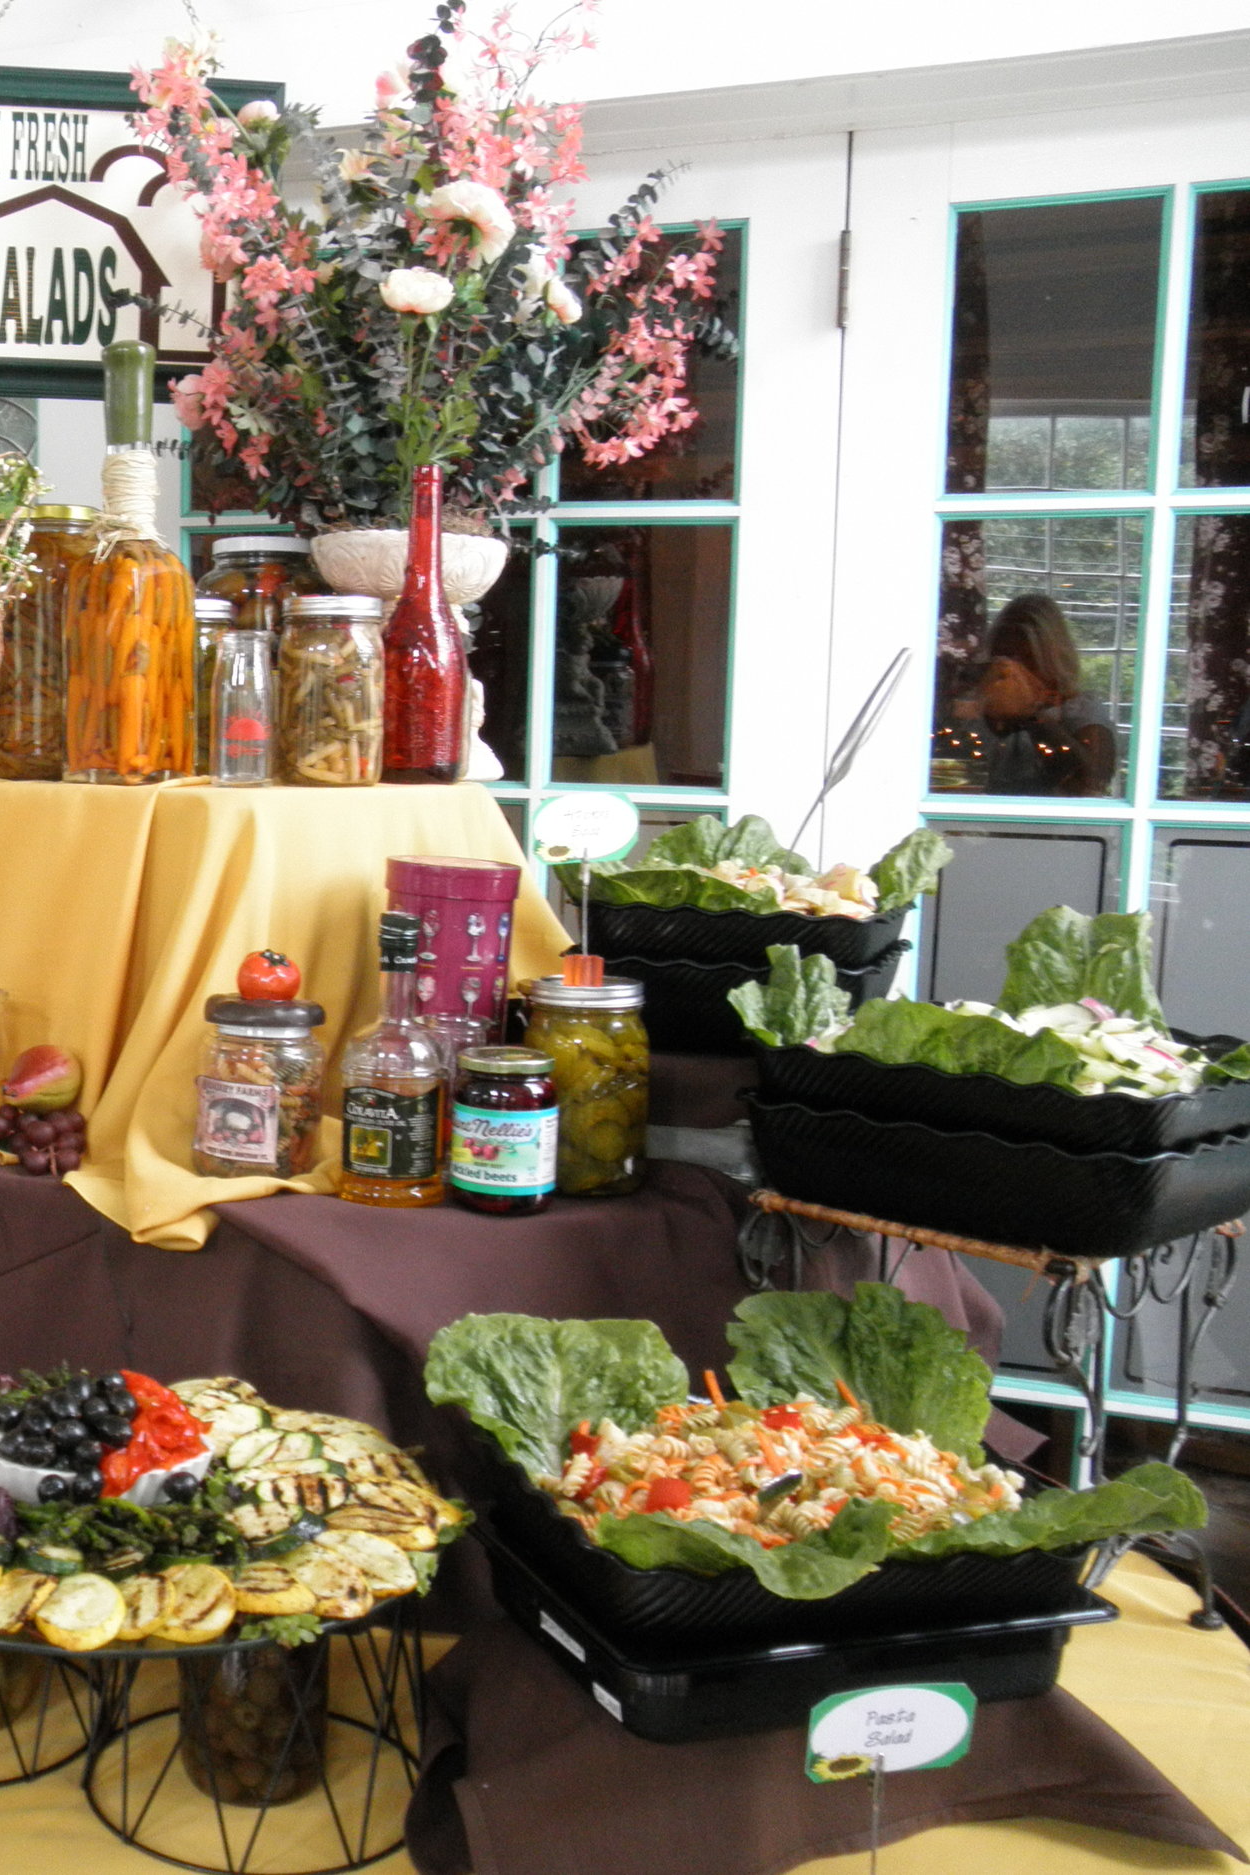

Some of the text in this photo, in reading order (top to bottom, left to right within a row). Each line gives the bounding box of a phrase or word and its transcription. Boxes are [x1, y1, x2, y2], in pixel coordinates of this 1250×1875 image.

[11, 111, 89, 183] FRESH
[483, 1171, 518, 1183] beets
[865, 1708, 917, 1727] Pasta
[864, 1729, 914, 1748] Salad
